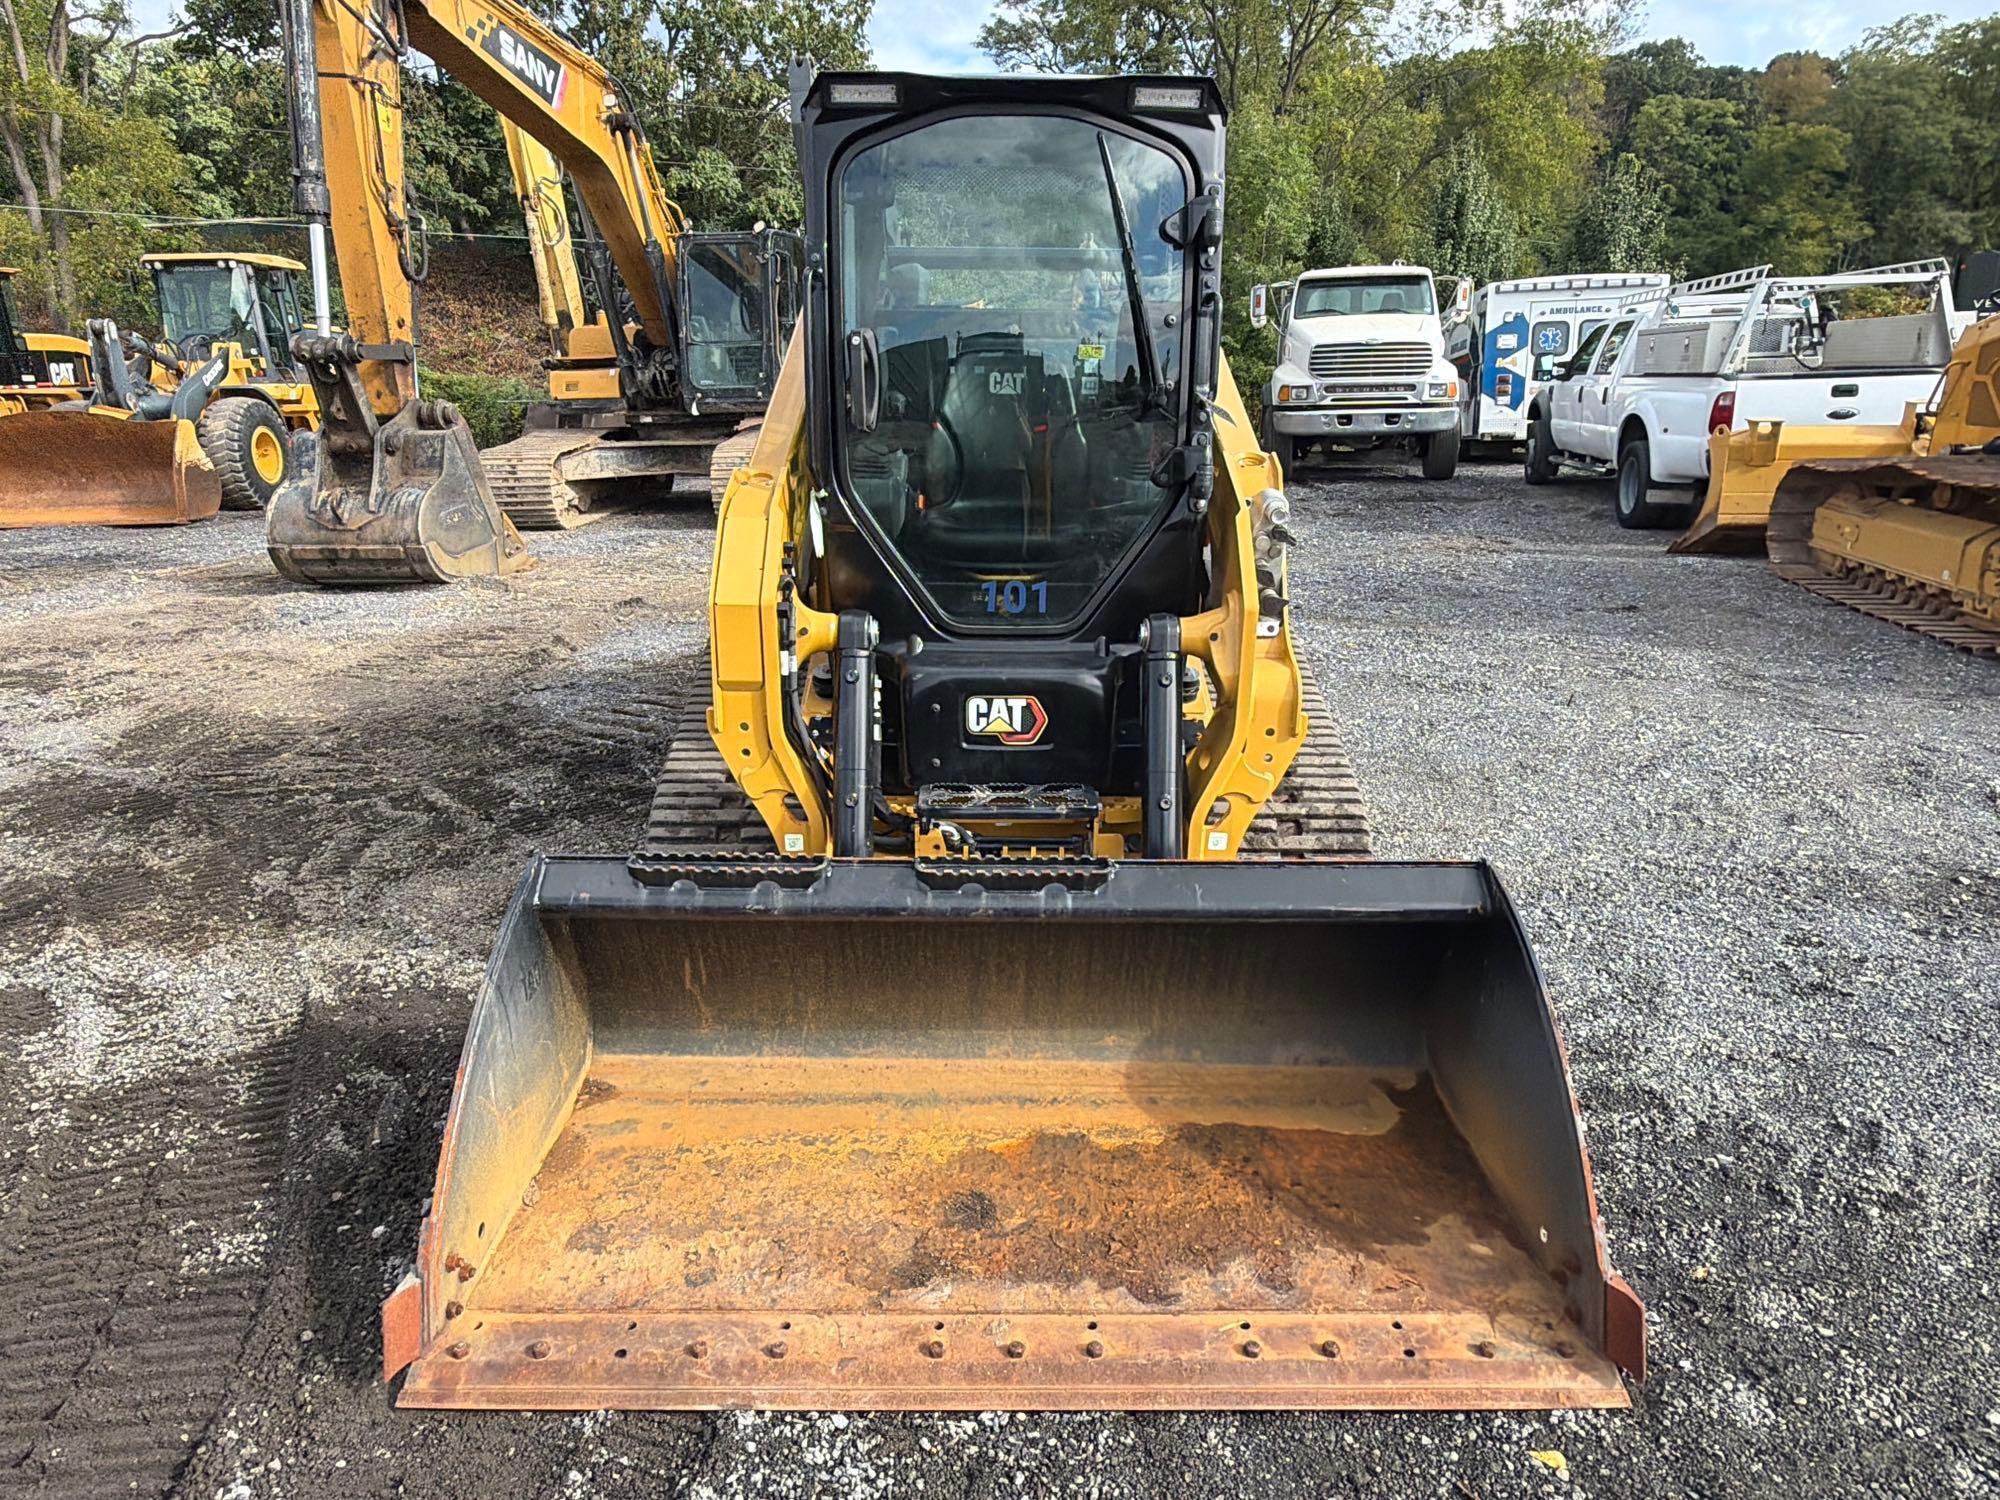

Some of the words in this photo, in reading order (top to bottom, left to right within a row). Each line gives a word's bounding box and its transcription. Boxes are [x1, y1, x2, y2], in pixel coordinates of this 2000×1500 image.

[499, 29, 556, 94] SANY
[1549, 305, 1604, 315] AMBULANCE
[1973, 299, 1993, 308] VE
[50, 362, 75, 386] CAT
[989, 371, 1025, 395] CAT
[981, 580, 1048, 614] 101
[968, 697, 1028, 733] CAT
